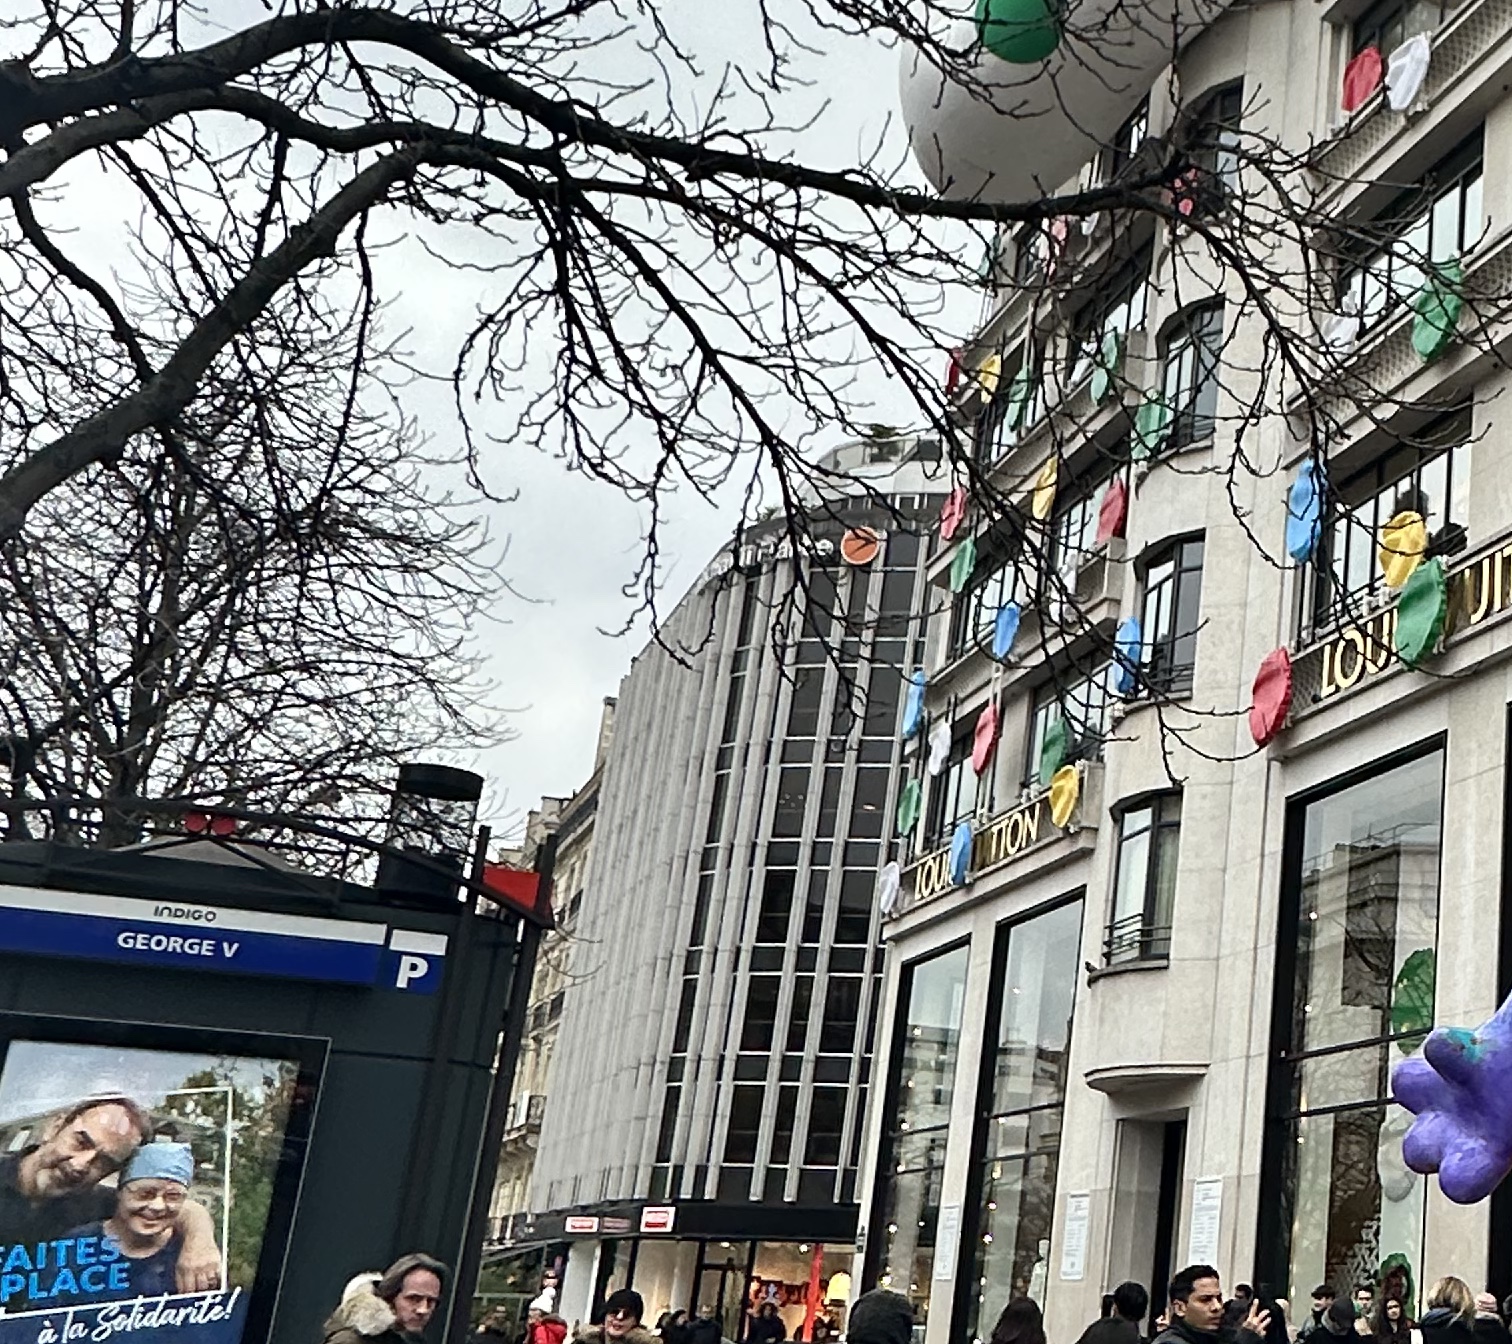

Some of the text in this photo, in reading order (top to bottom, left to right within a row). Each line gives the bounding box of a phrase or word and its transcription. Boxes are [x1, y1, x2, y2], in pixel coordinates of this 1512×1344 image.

[1321, 607, 1400, 698] LOUI
[914, 849, 953, 901] LOUI
[153, 905, 218, 923] INDIGO
[116, 931, 240, 958] GEORGE V
[396, 954, 430, 989] P
[0, 1262, 131, 1302] PLACE
[61, 1309, 88, 1344] la
